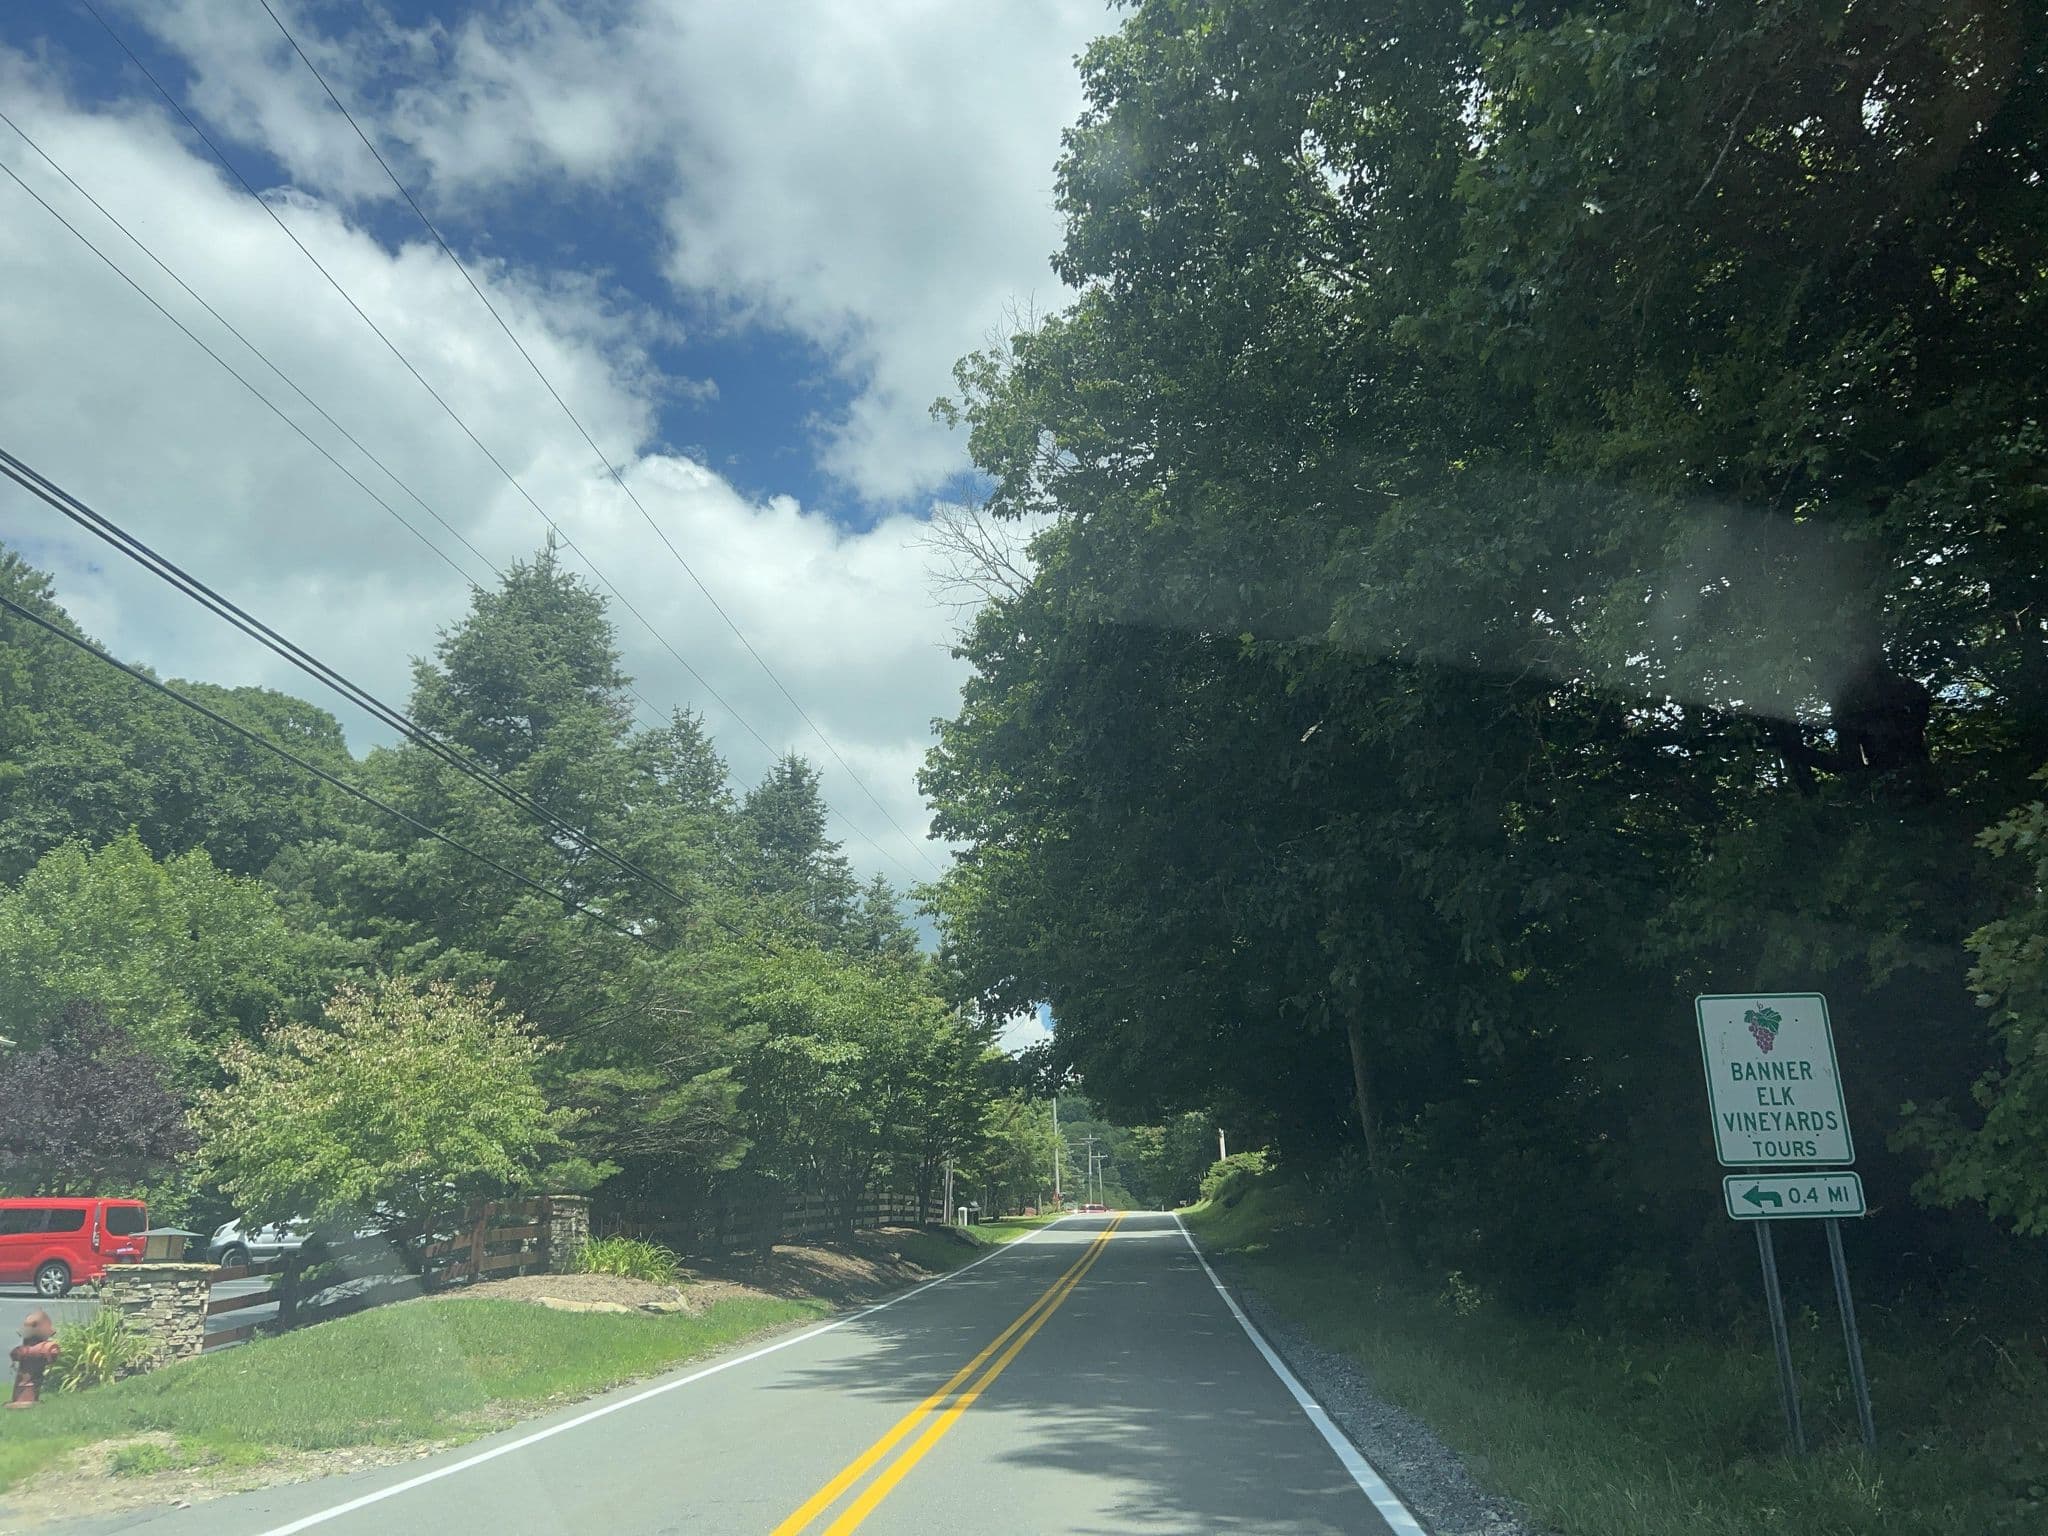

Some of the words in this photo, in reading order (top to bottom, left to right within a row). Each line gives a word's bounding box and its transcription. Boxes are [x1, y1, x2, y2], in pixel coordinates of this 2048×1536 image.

[1731, 1061, 1813, 1081] BANNER
[1757, 1086, 1795, 1106] ELK
[1723, 1111, 1838, 1132] VINEYARDS
[1752, 1140, 1817, 1157] TOURS
[1788, 1187, 1819, 1204] 0.4
[1828, 1186, 1849, 1203] MI
